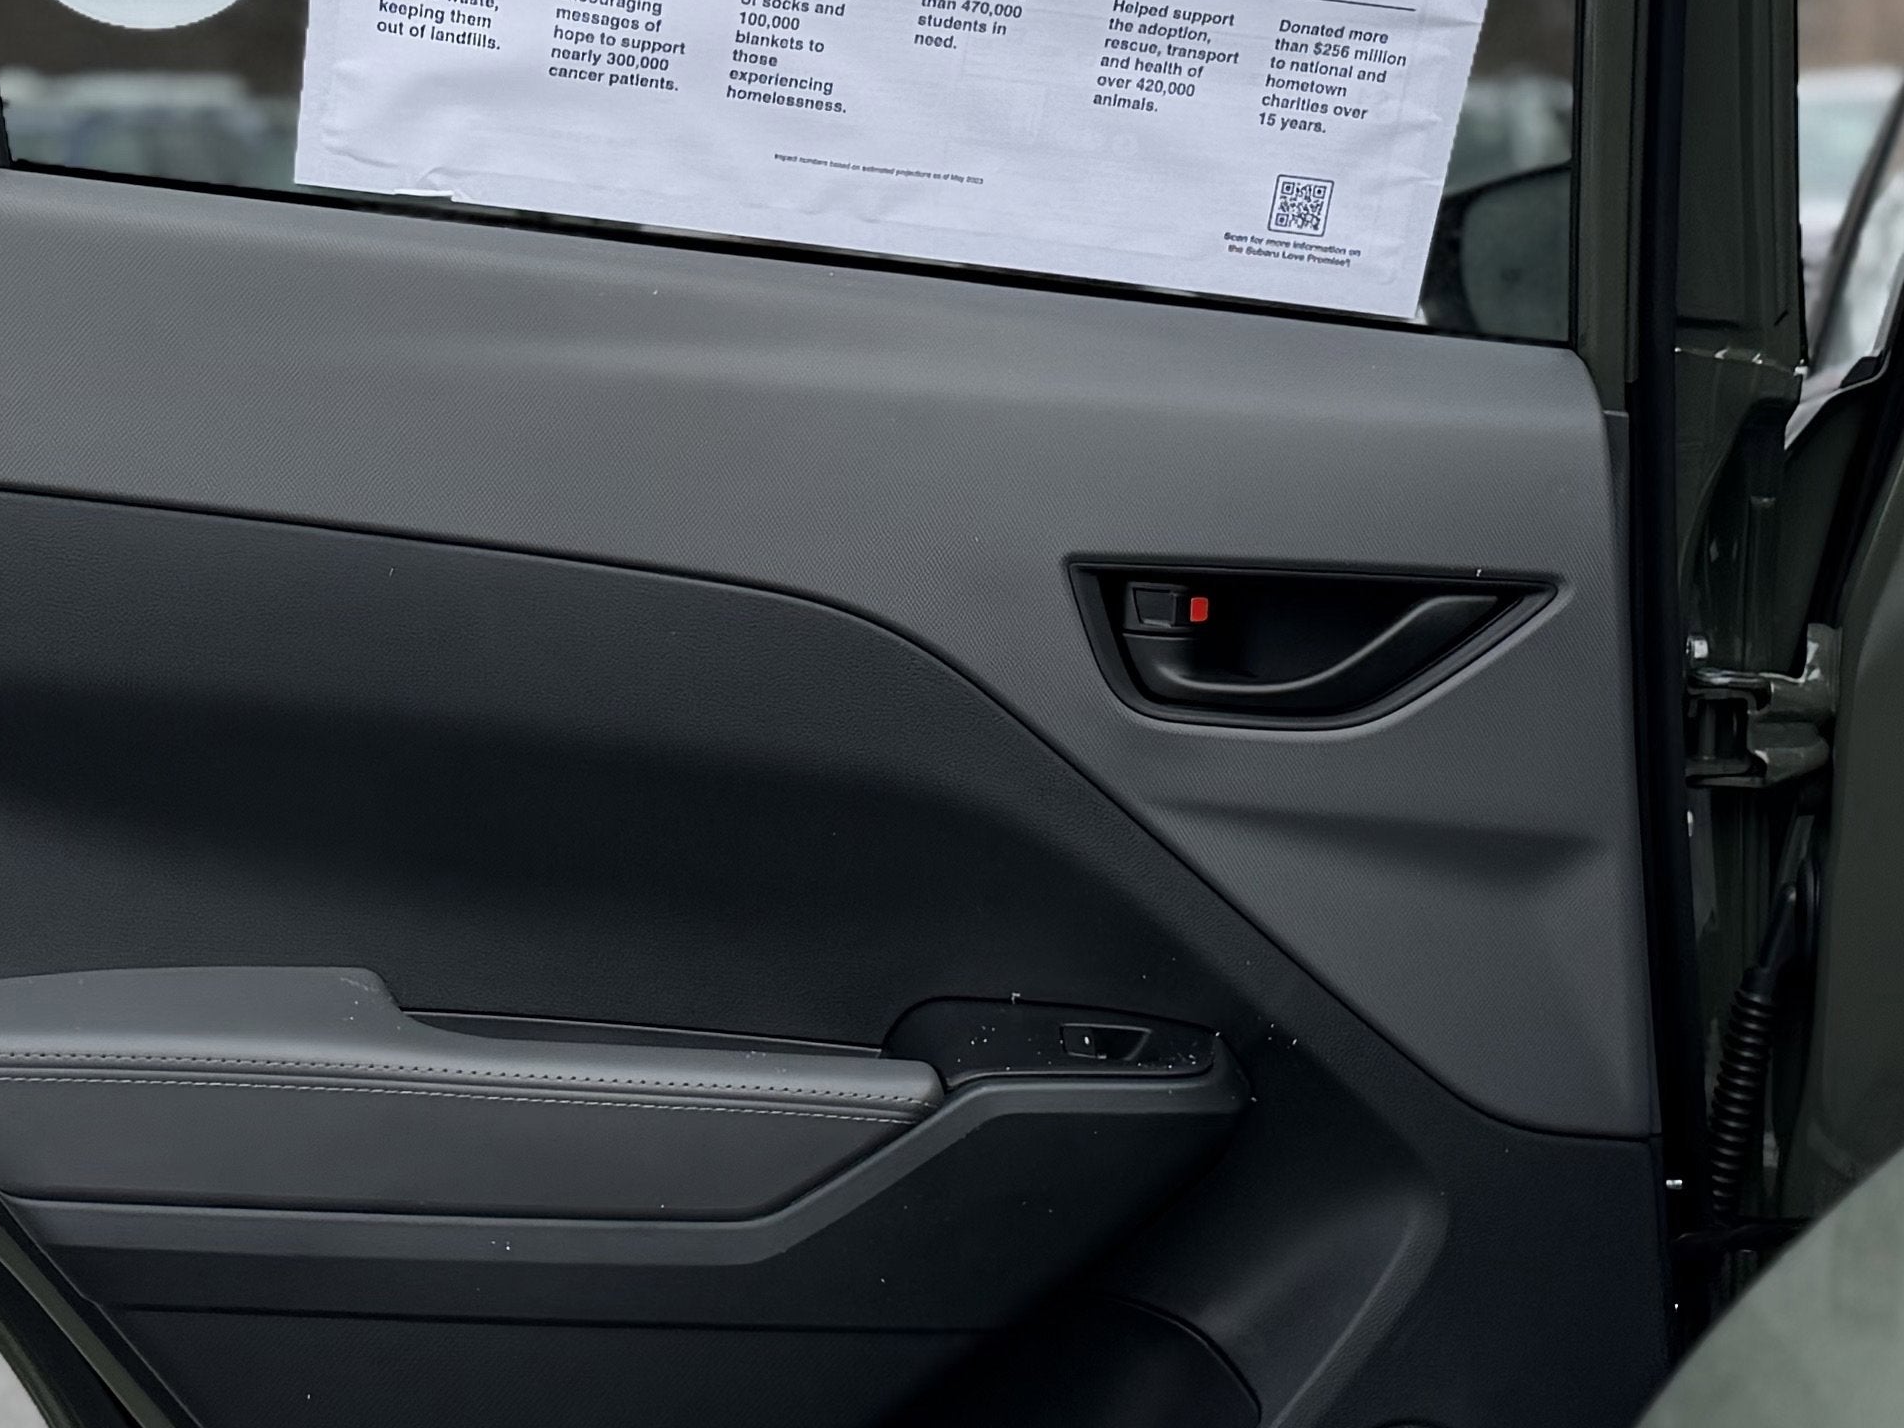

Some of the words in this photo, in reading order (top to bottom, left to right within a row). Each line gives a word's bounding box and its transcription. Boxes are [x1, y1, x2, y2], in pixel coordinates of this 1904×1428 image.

[450, 9, 491, 28] them
[556, 8, 639, 30] messages
[644, 19, 662, 33] of
[739, 11, 800, 30] 100,000
[814, 3, 845, 17] and
[960, 0, 1022, 18] 470,000
[1172, 9, 1234, 26] support
[376, 21, 403, 36] out
[409, 24, 426, 38] of
[430, 25, 500, 50] landfills.
[917, 14, 987, 33] students
[992, 21, 1007, 35] in
[1108, 17, 1134, 32] the
[1137, 22, 1211, 45] adoption,
[1278, 19, 1345, 39] Donated
[1348, 29, 1388, 44] more
[553, 24, 595, 45] hope
[600, 32, 616, 46] to
[620, 37, 685, 55] support
[734, 29, 803, 51] blankets
[809, 39, 824, 53] to
[913, 34, 957, 49] need.
[1104, 38, 1161, 57] rescue,
[1166, 43, 1239, 64] transport
[550, 47, 602, 66] nearly
[606, 52, 669, 71] 300,000
[732, 48, 778, 67] those
[1274, 38, 1308, 53] than
[1312, 41, 1350, 58] $256
[1354, 48, 1406, 67] million
[548, 66, 605, 82] cancer
[608, 73, 678, 91] patients.
[1100, 56, 1130, 69] and
[1134, 57, 1182, 76] health
[1187, 65, 1204, 78] of
[1270, 56, 1286, 69] to
[1289, 60, 1353, 78] national
[1356, 70, 1387, 83] and
[729, 69, 833, 96] experiencing
[1096, 75, 1132, 89] over
[1136, 77, 1195, 97] 420,000
[1265, 73, 1347, 97] hometown
[726, 84, 846, 113] homelessness.
[1092, 93, 1157, 112] animals.
[1261, 93, 1328, 114] charities
[1333, 105, 1368, 120] over
[1259, 112, 1276, 126] 15
[1279, 117, 1326, 133] years.
